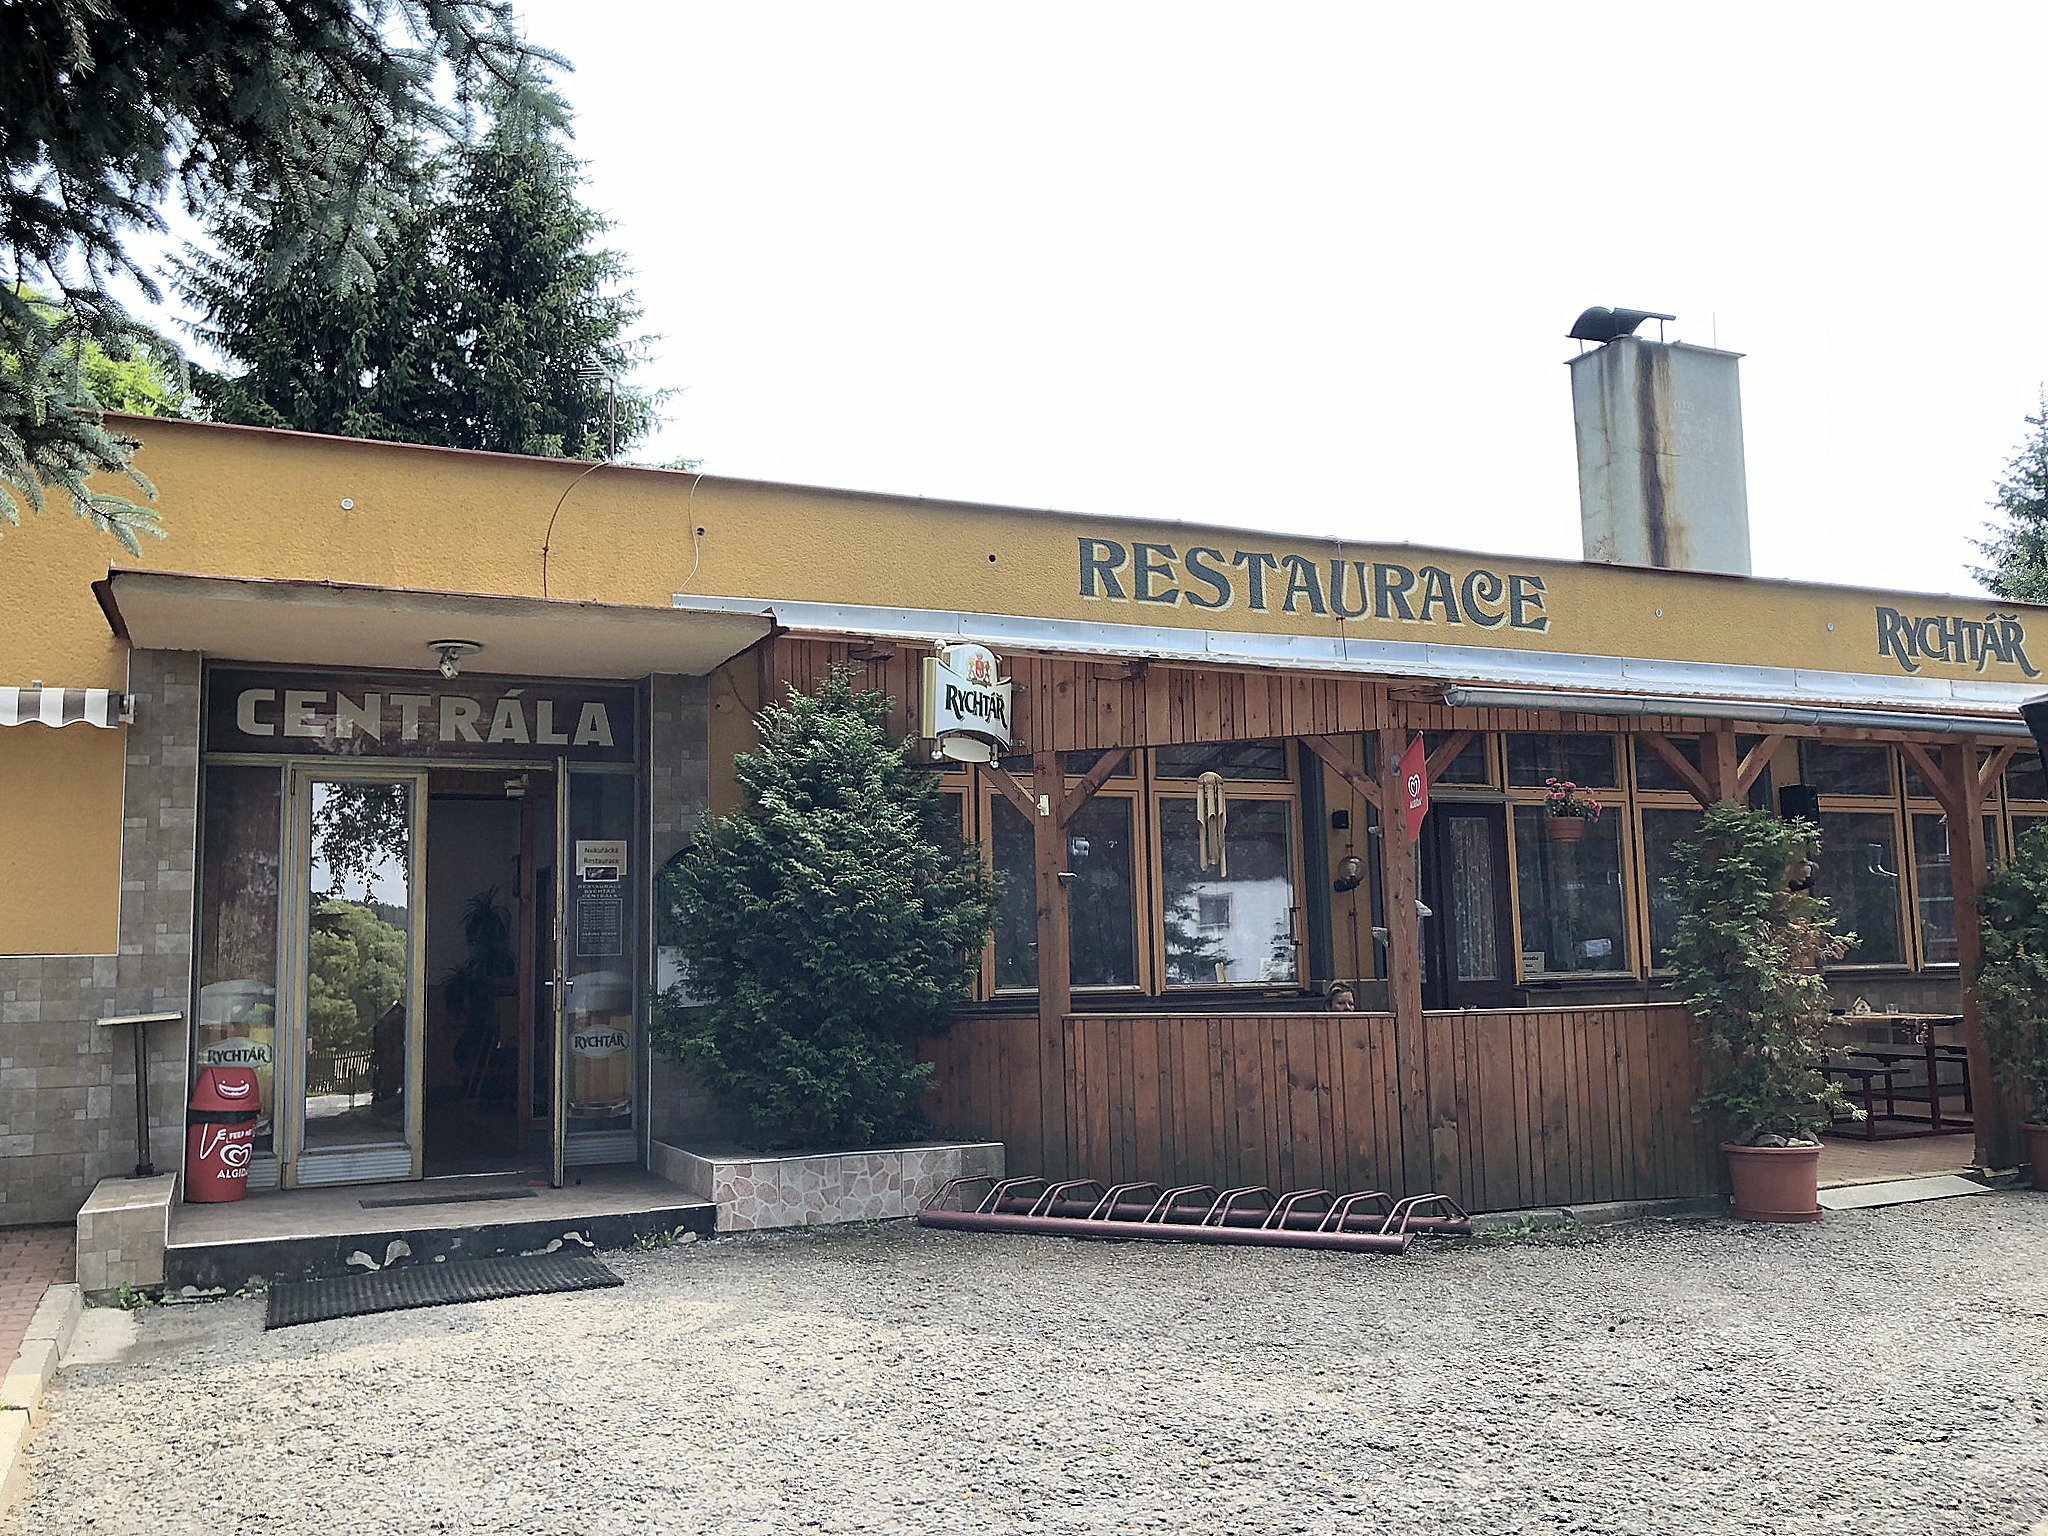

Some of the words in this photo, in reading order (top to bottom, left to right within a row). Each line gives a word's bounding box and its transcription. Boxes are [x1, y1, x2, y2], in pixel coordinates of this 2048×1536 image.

[1077, 537, 1550, 634] RESTAURACE
[1875, 606, 2043, 679] RYCHTÁŘ
[236, 688, 615, 747] CENTRÁLA
[945, 683, 1009, 731] RYCHTÁŘ
[207, 1045, 269, 1065] RYCHTÁŘ
[575, 1032, 626, 1050] RYCHTÁŘ
